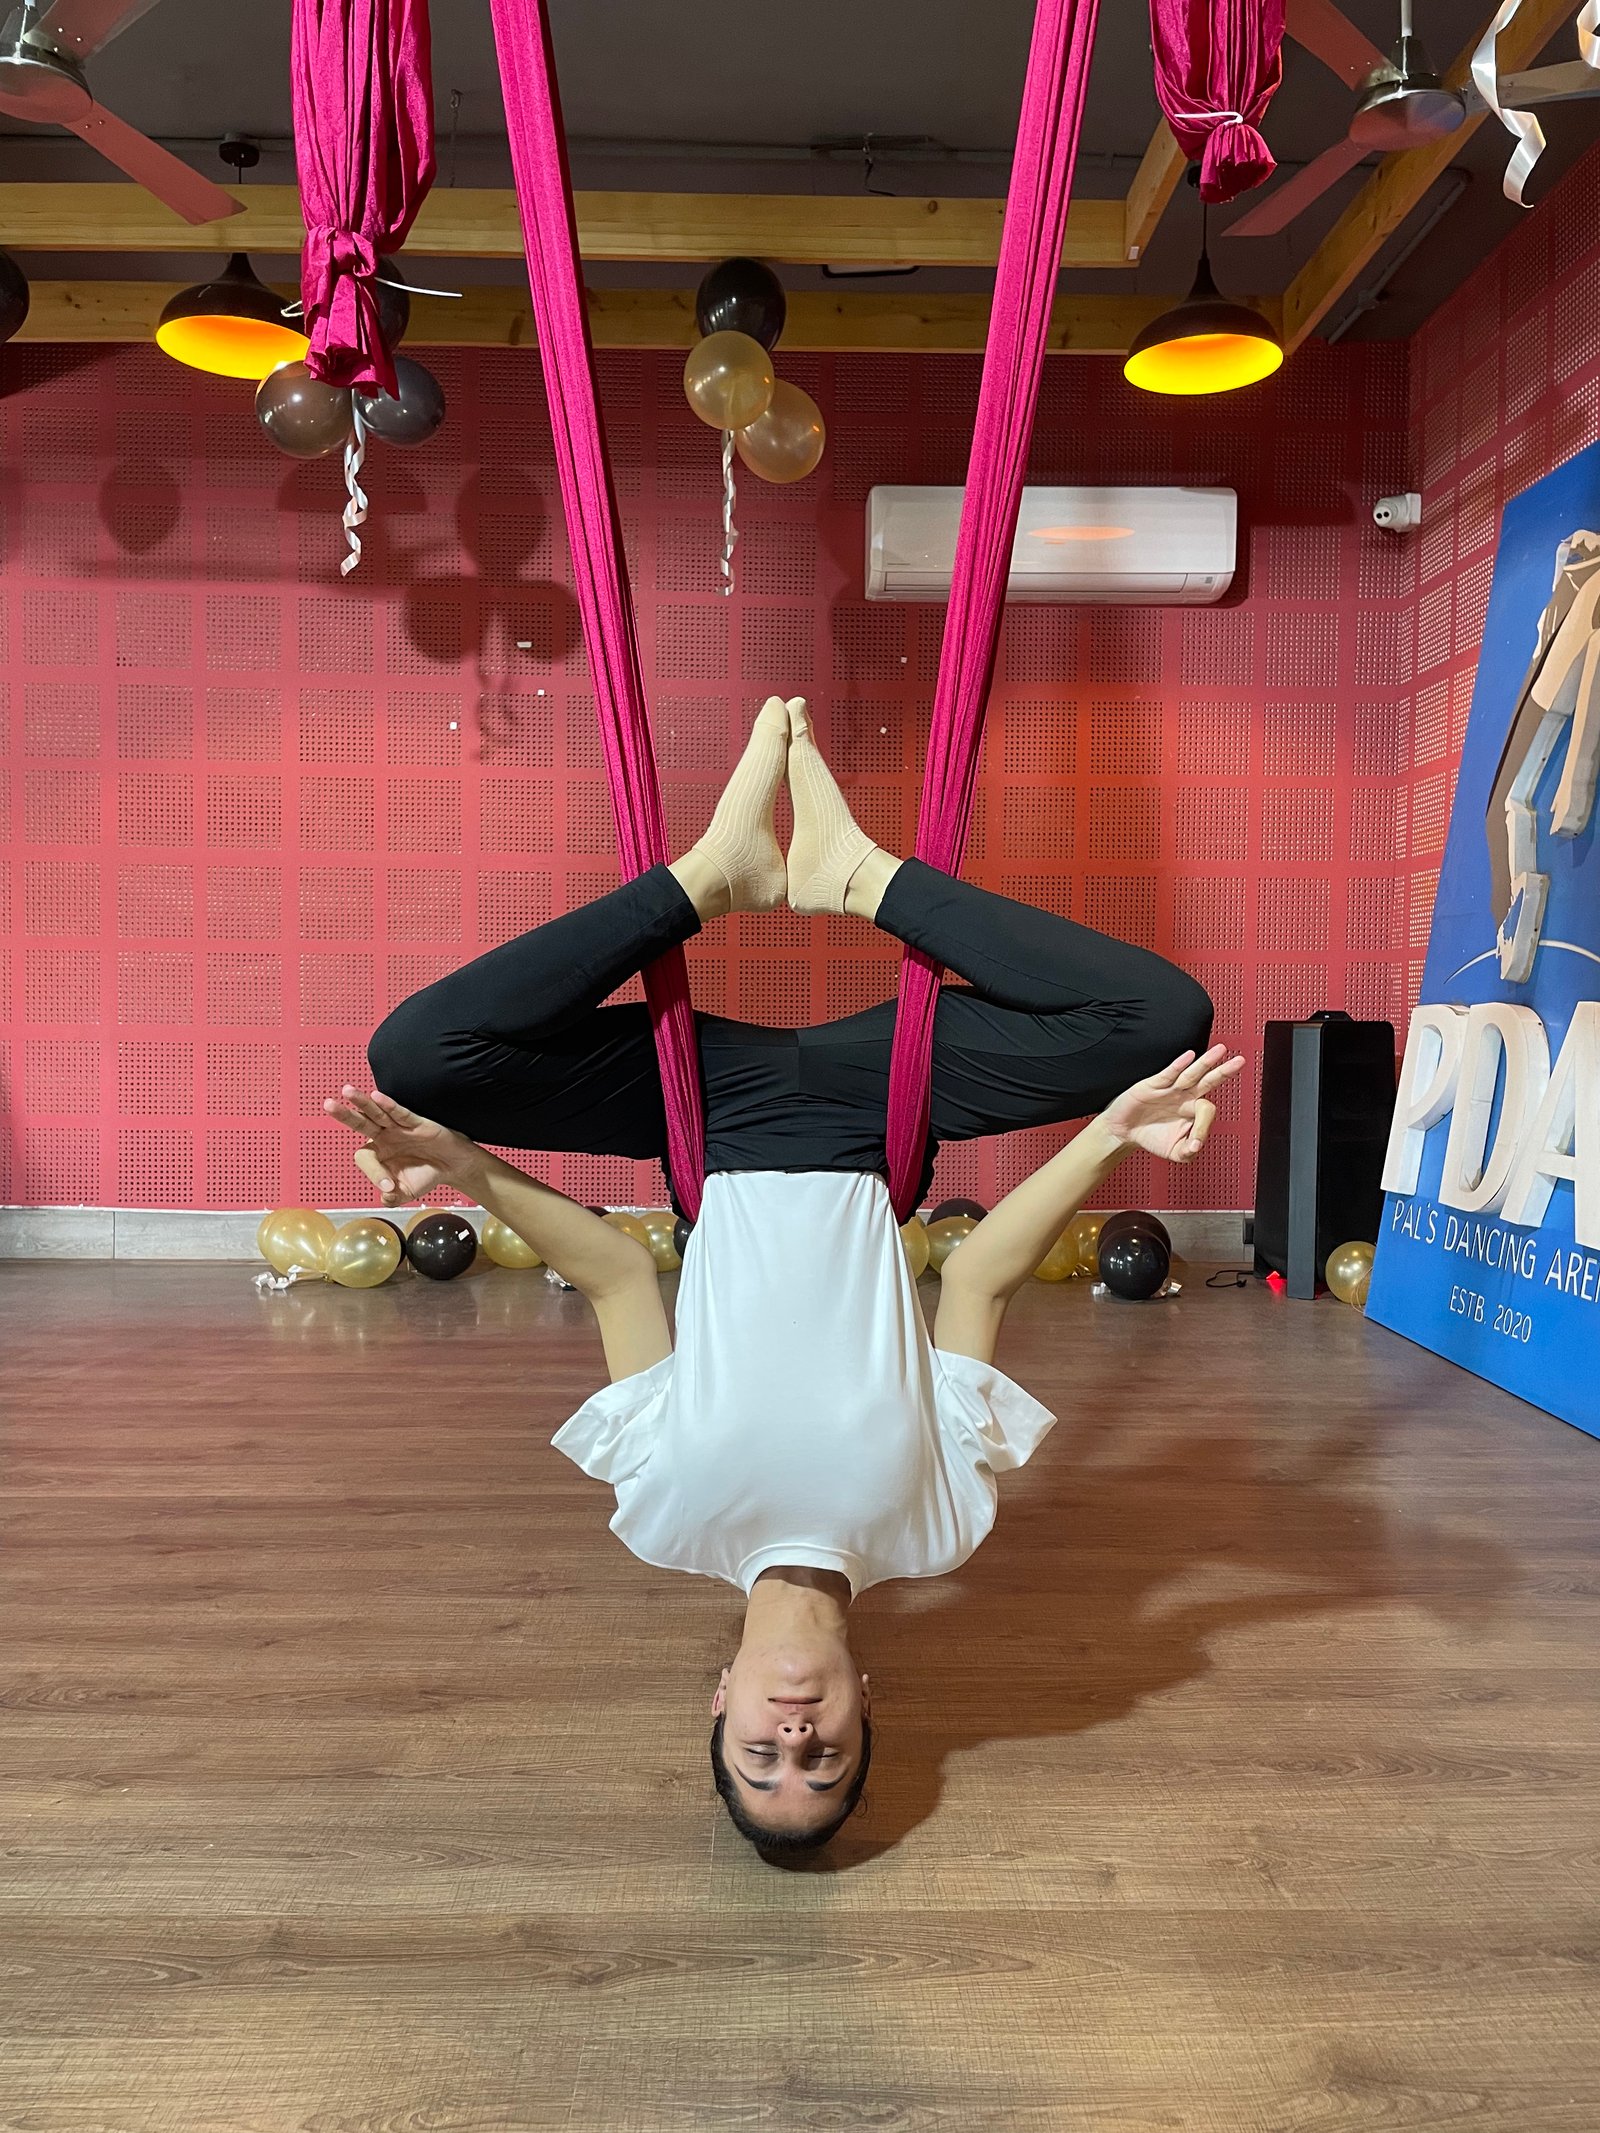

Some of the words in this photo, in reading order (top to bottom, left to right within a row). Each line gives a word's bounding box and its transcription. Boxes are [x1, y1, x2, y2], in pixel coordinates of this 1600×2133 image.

[1380, 1001, 1600, 1252] PDA
[1392, 1199, 1438, 1244] PAL'S
[1443, 1205, 1537, 1280] DANCING
[1544, 1248, 1600, 1303] ARE
[1449, 1285, 1486, 1325] ESTB.
[1493, 1304, 1532, 1343] 2020
